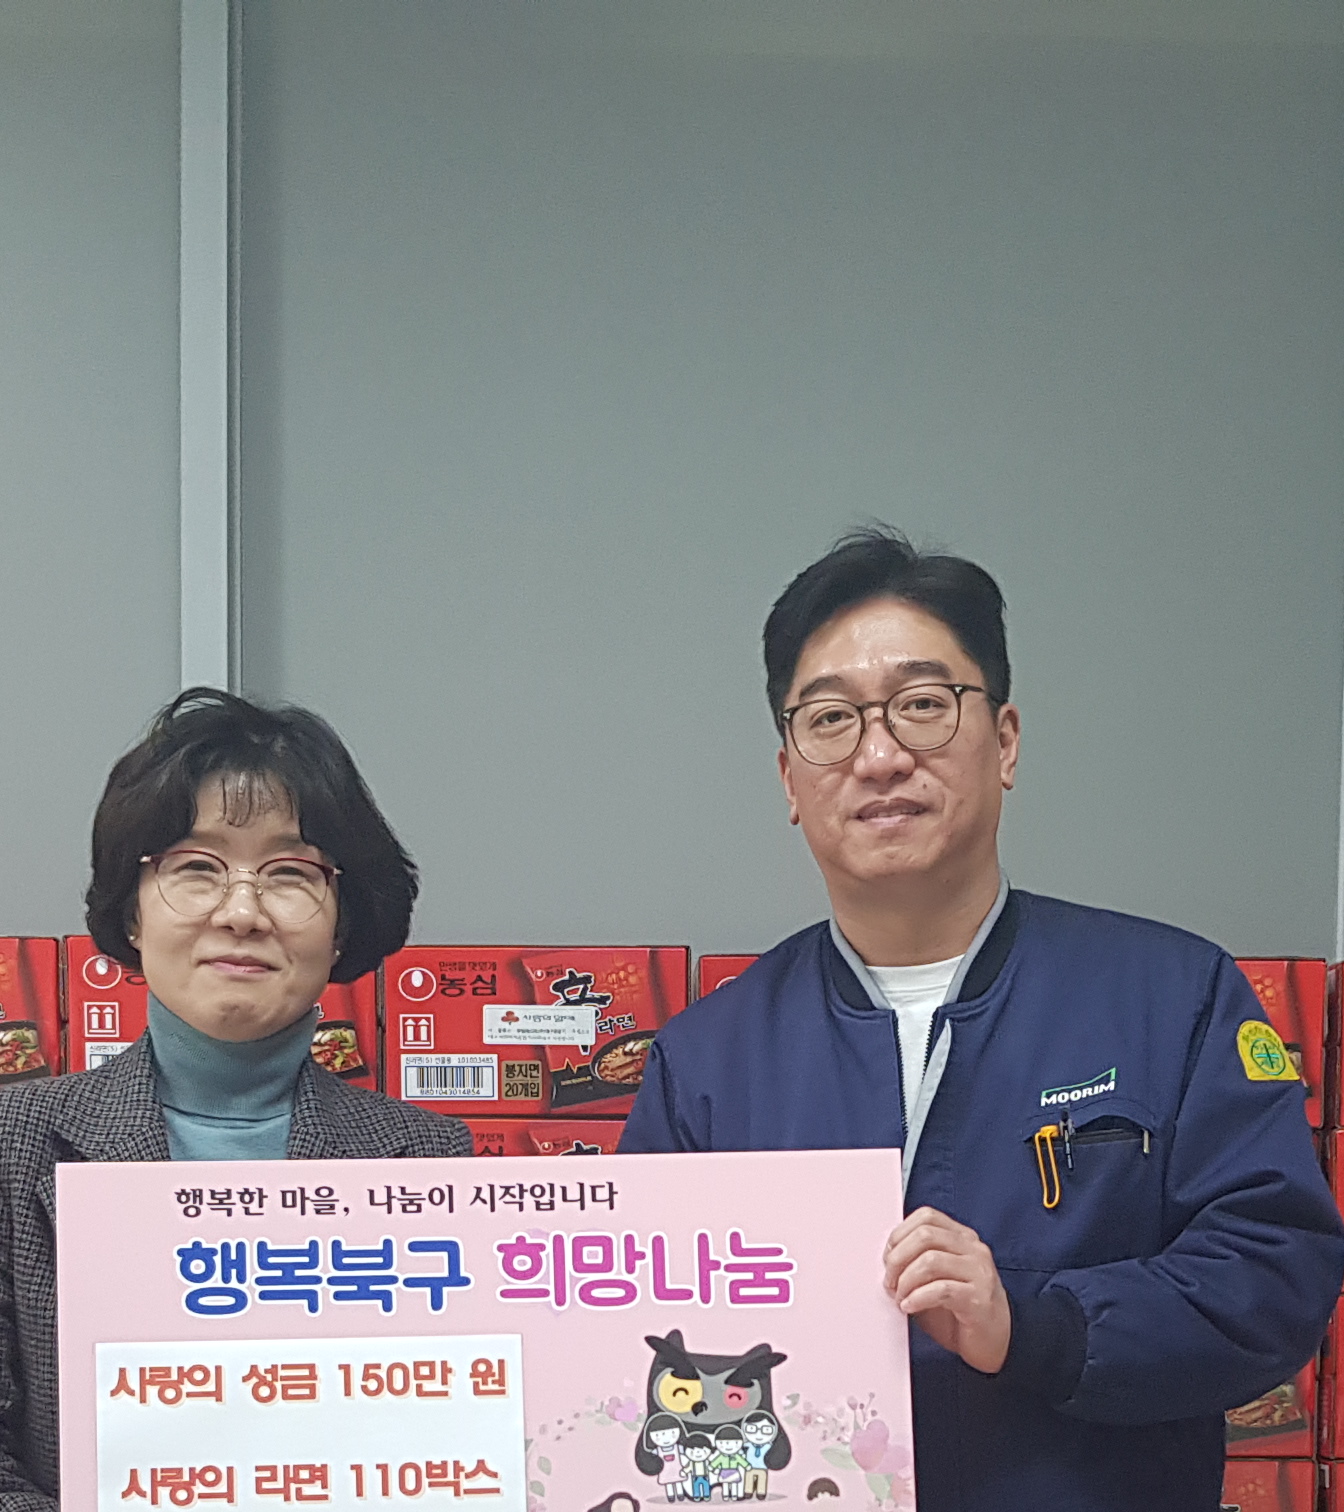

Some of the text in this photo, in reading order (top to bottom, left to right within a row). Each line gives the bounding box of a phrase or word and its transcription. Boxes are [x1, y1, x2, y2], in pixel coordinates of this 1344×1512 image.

[439, 974, 497, 997] 농심
[597, 1015, 637, 1034] 라면
[505, 1064, 540, 1079] 봉지면
[505, 1083, 540, 1098] 20개입
[1040, 1081, 1115, 1106] MOORIM
[175, 1182, 617, 1217] 행복한 마을, 나눔이 시작입니다
[177, 1231, 796, 1315] 행복북구 희망나눔
[110, 1357, 507, 1406] 사랑의 성금 150만 원
[121, 1460, 502, 1507] 사랑의 라면 110박스
